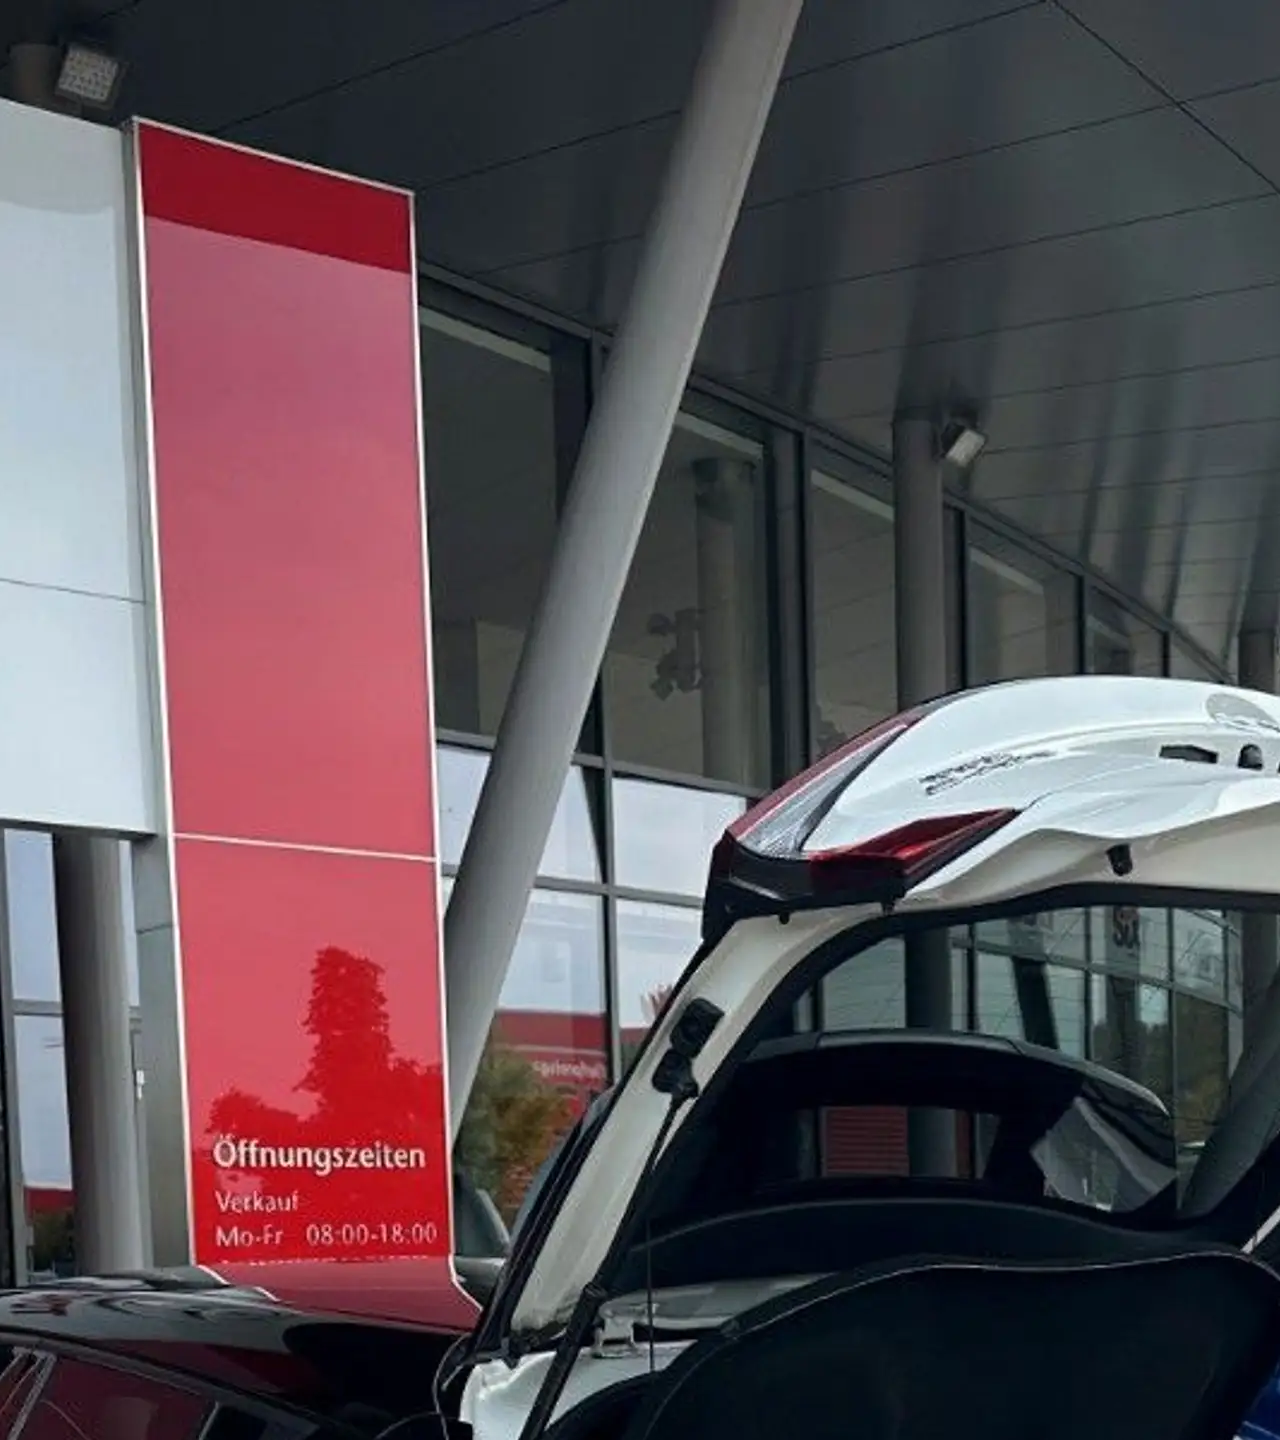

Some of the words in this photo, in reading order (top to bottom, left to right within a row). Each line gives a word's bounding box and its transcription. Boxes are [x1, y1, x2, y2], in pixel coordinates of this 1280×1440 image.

[213, 1134, 426, 1177] Öffnungszeiten
[215, 1189, 300, 1213] Verkauf
[215, 1225, 283, 1247] Mo-Fr
[306, 1222, 437, 1245] 08:00-18:00
